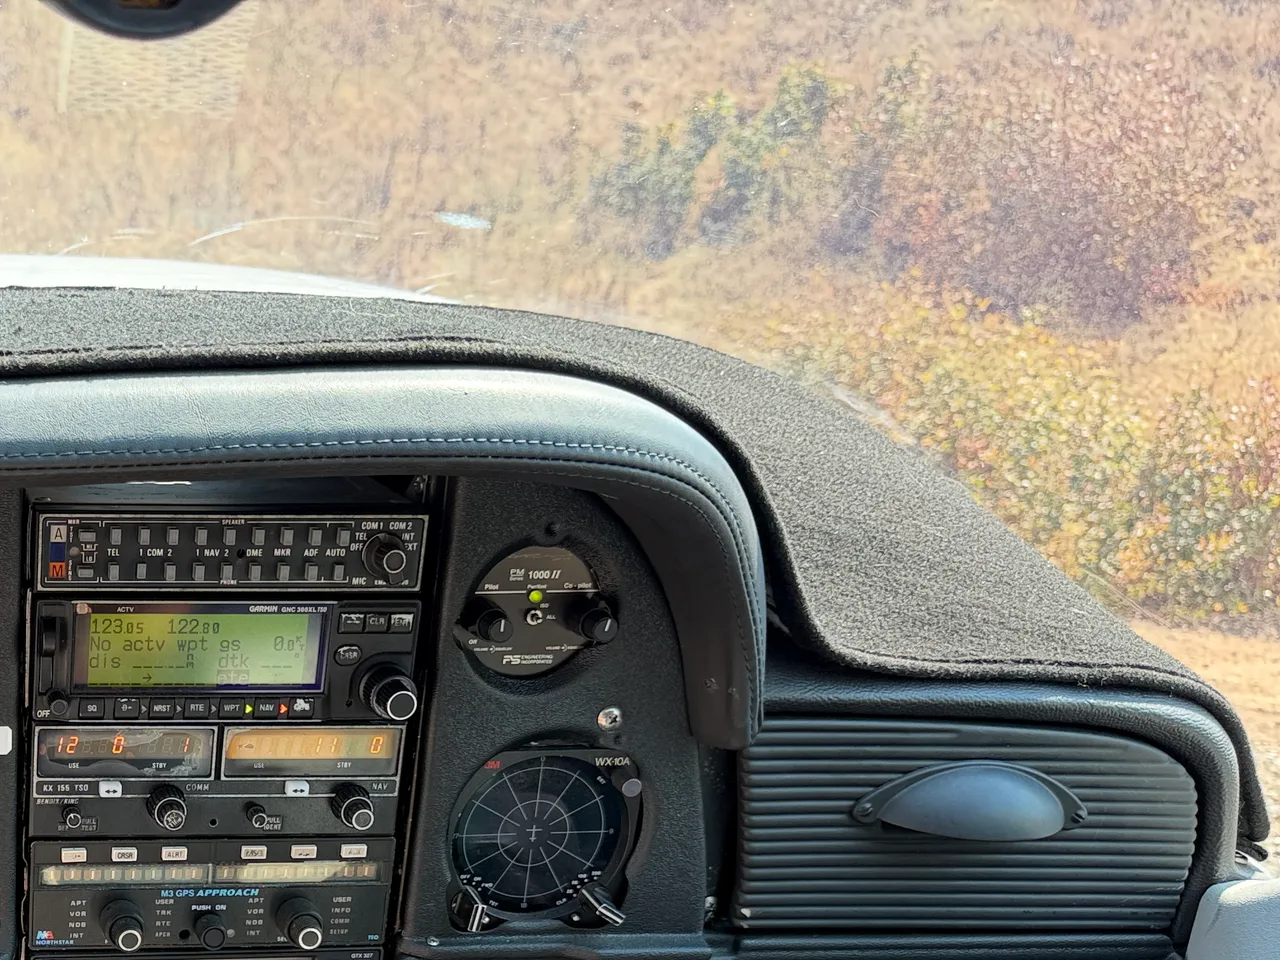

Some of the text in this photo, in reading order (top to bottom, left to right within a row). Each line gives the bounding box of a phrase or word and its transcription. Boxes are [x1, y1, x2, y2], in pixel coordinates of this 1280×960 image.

[247, 549, 263, 557] DME
[326, 549, 346, 557] AUTO
[528, 571, 550, 580] 1000
[91, 619, 220, 634] 123.05 122.80
[90, 636, 208, 653] No actv wpt
[90, 654, 121, 669] dis
[224, 704, 240, 712] WPT
[176, 889, 195, 898] GPS
[196, 888, 260, 897] APPROACH
